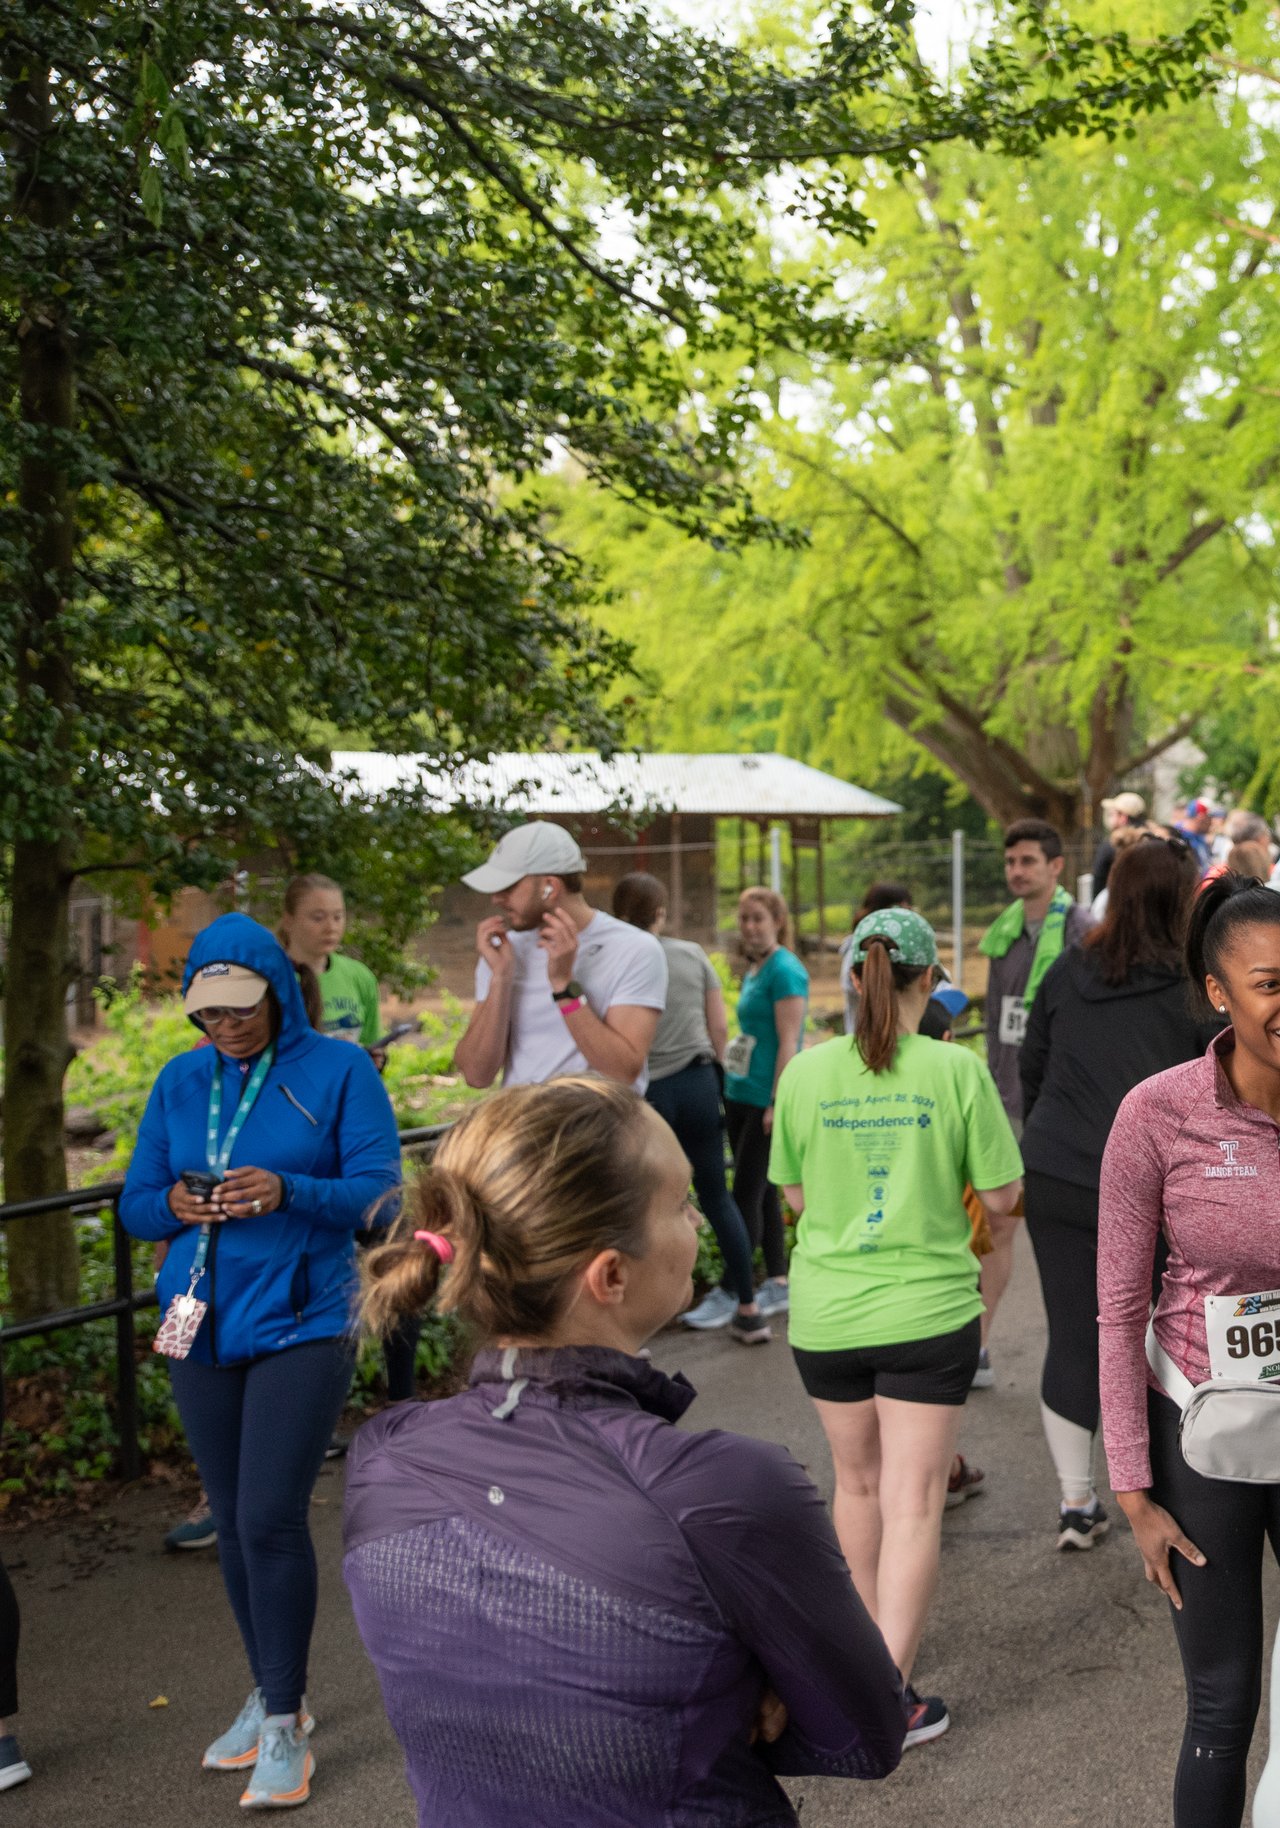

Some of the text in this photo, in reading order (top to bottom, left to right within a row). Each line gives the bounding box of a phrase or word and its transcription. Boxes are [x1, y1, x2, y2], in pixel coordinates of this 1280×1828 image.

[822, 1116, 914, 1131] Independence
[1219, 1140, 1239, 1165] T
[1205, 1166, 1257, 1178] DANCE TEAM
